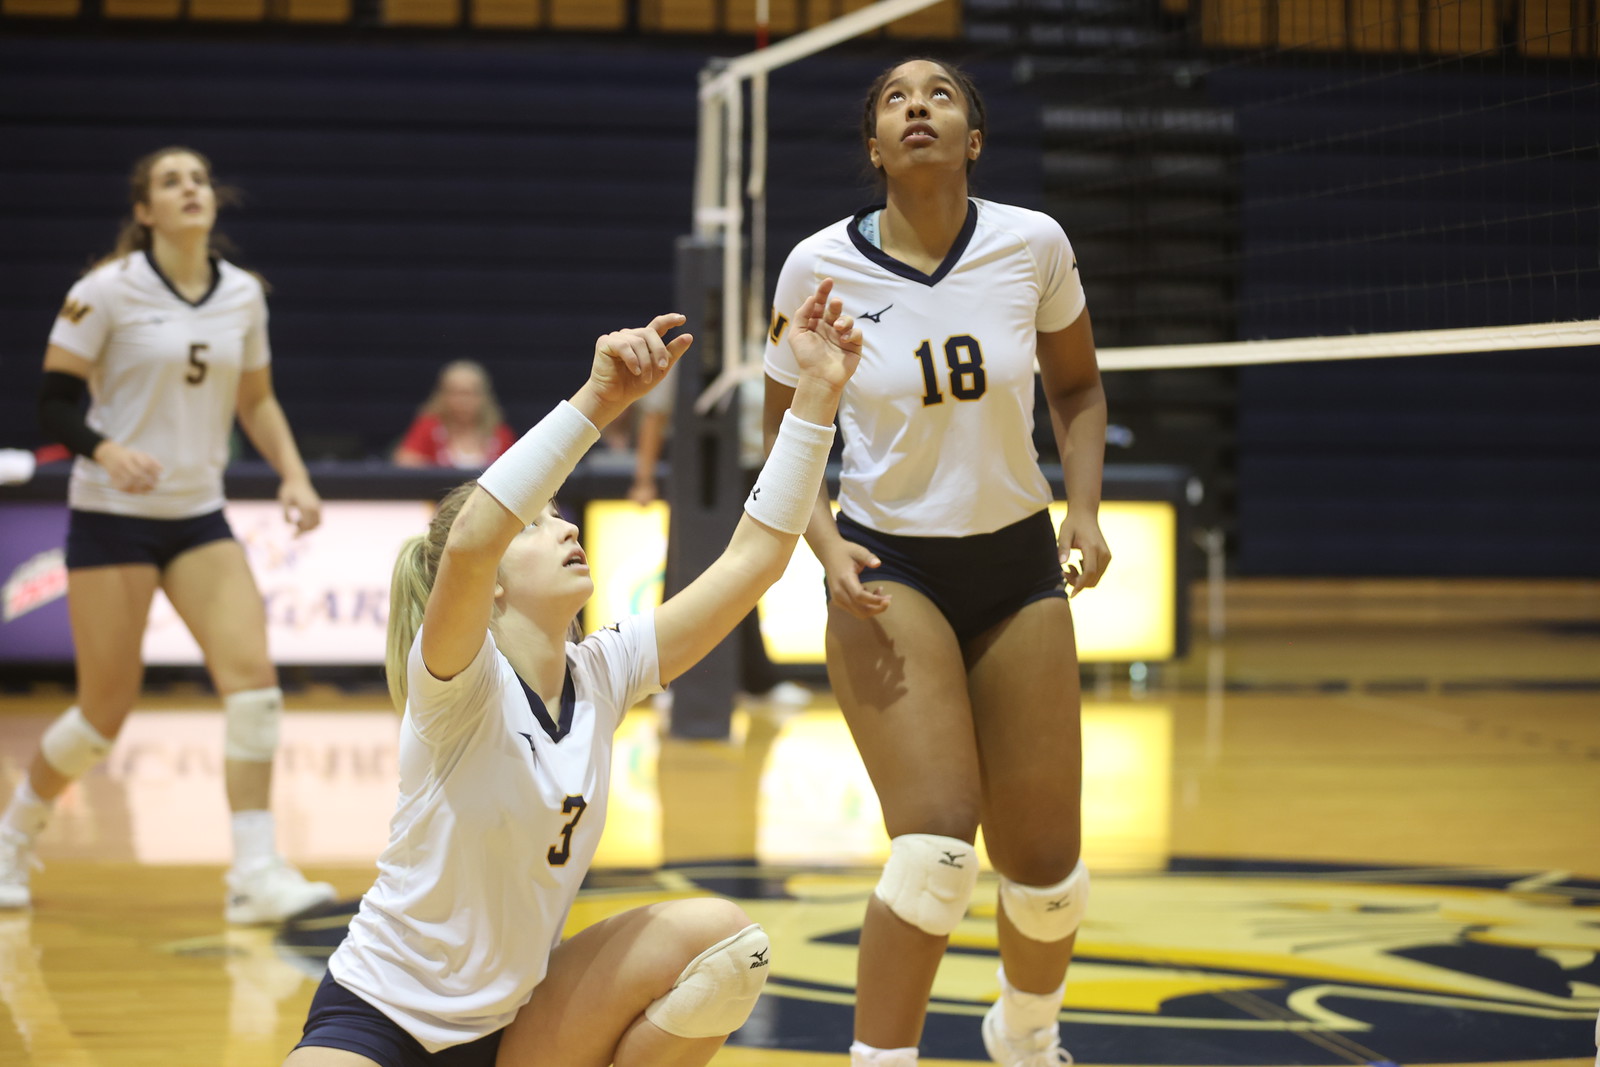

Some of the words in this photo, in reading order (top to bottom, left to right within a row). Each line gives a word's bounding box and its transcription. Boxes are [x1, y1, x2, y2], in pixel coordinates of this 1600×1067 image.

[184, 342, 209, 384] 5
[913, 333, 988, 407] 18
[546, 793, 588, 868] 3
